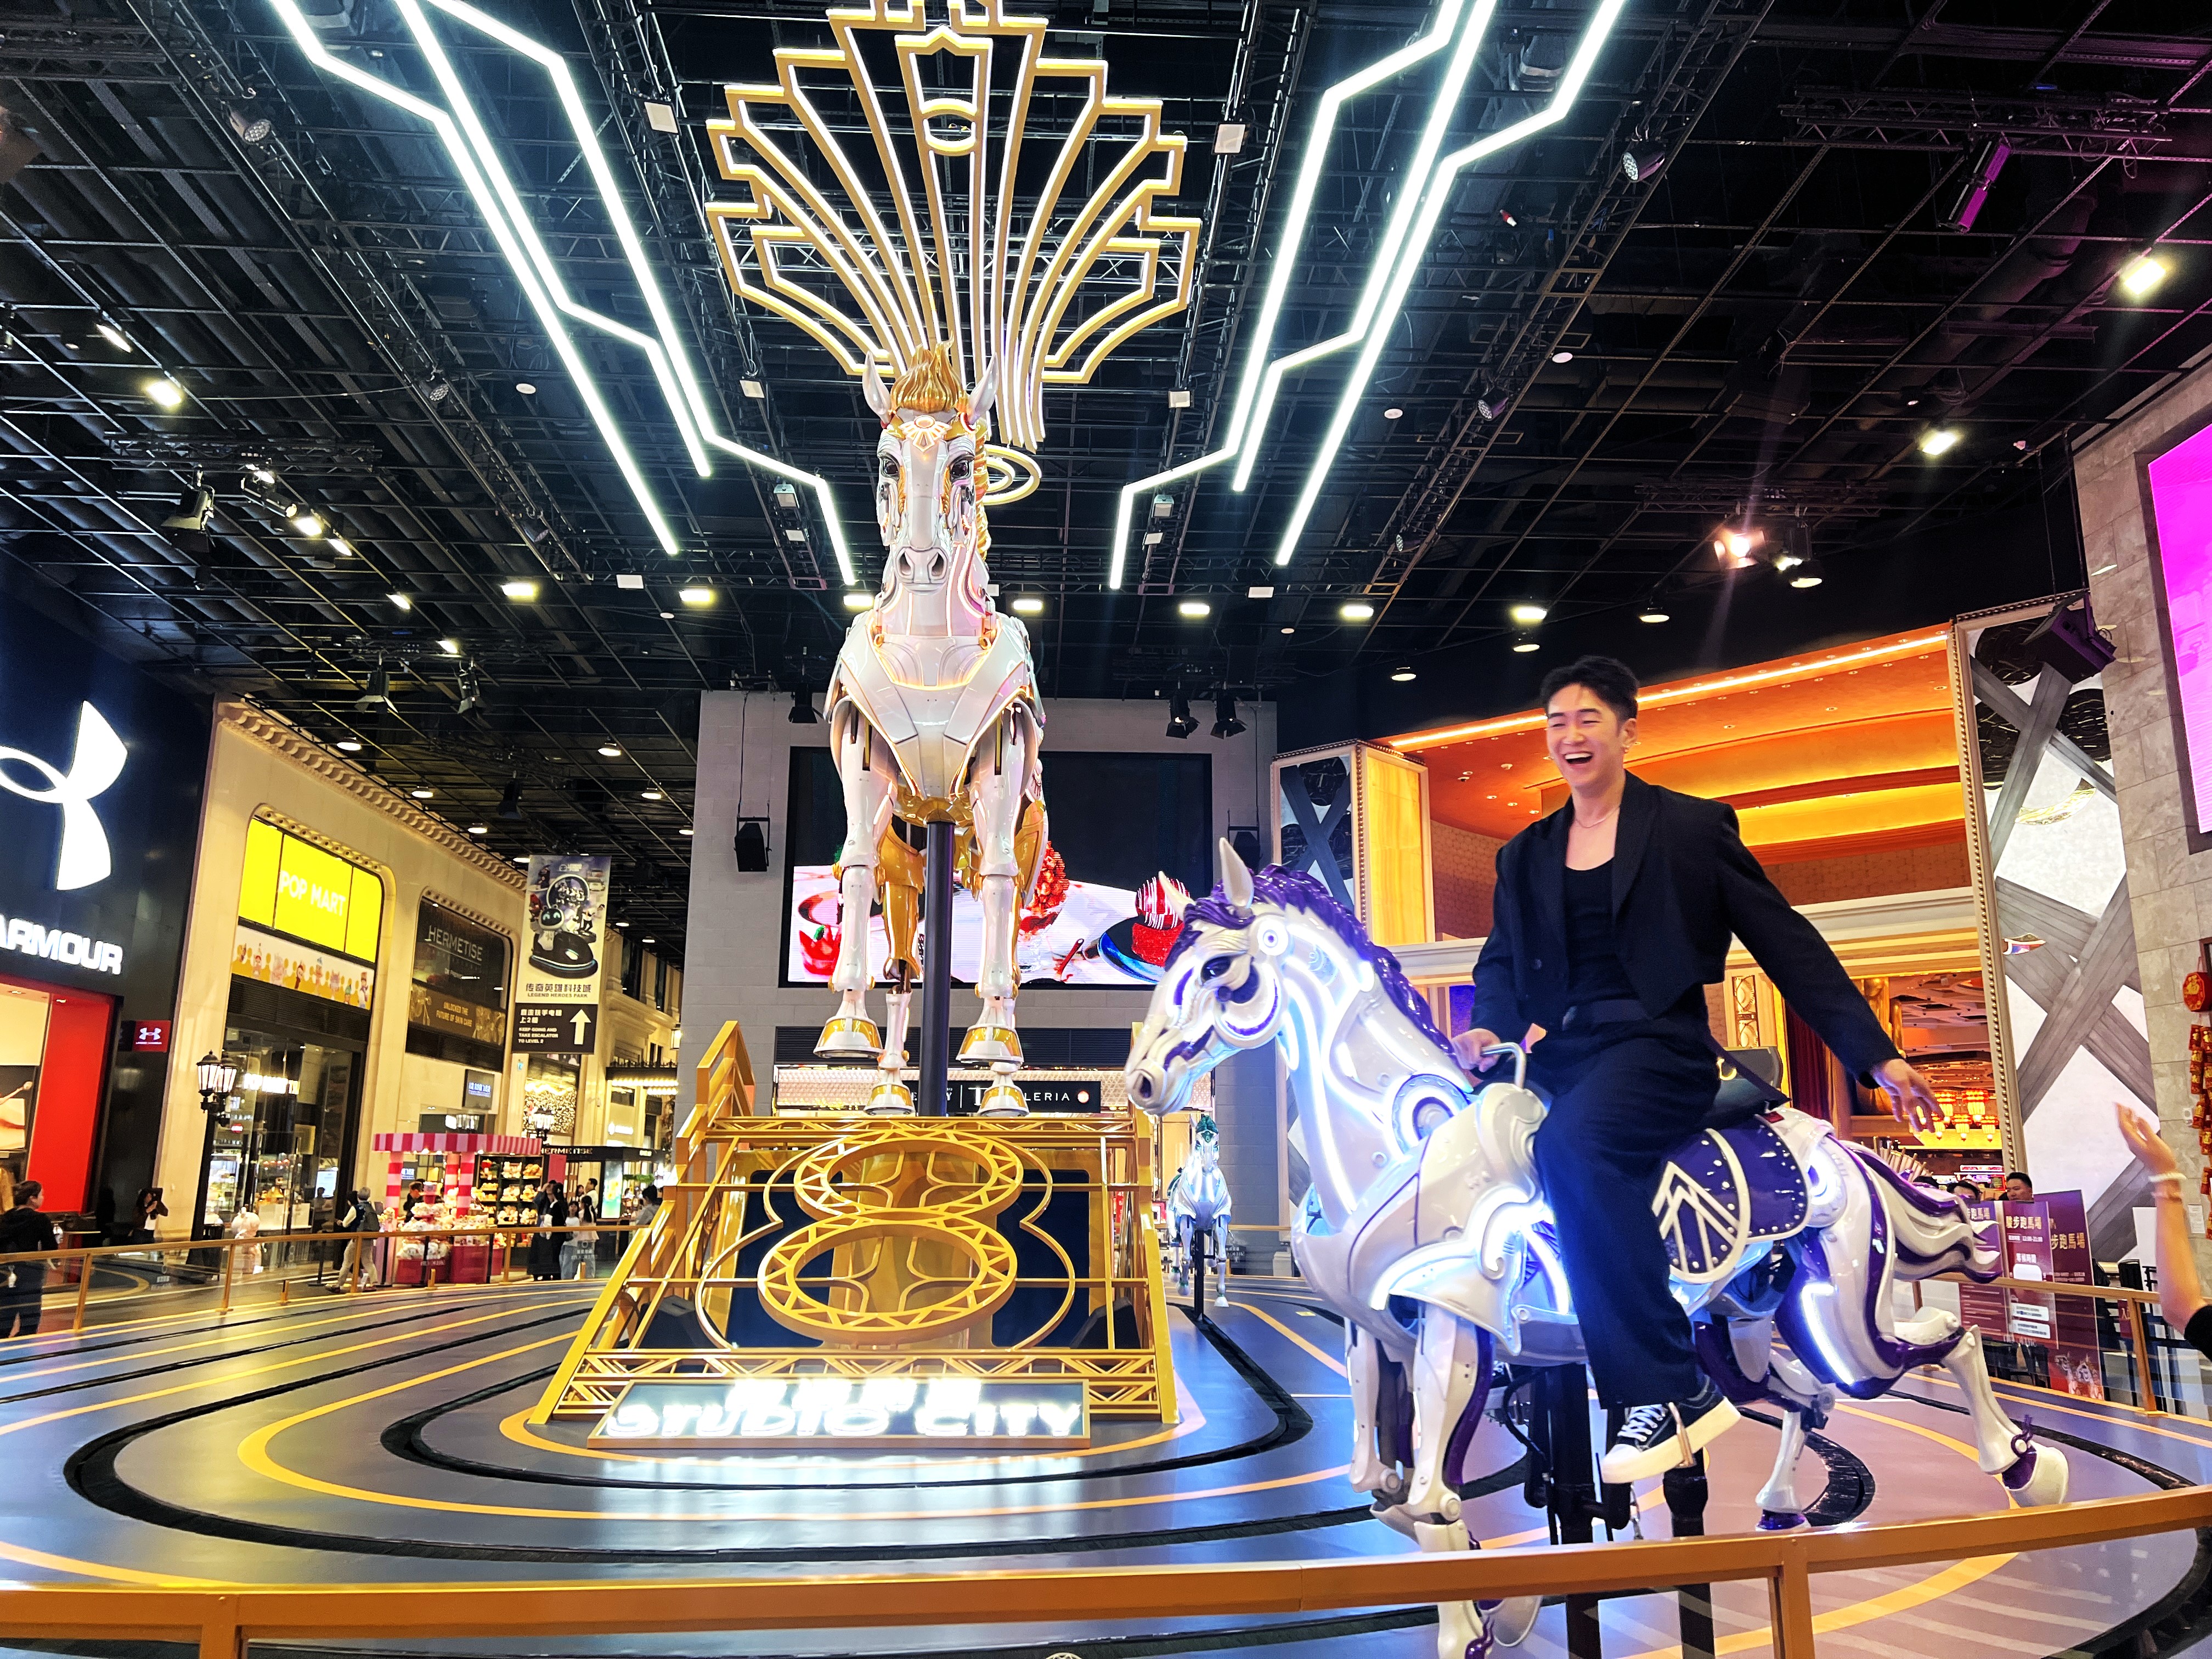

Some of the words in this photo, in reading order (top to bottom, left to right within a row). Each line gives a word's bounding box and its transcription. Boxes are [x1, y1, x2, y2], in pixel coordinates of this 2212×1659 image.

[278, 870, 307, 900] POP
[311, 883, 346, 916] MART
[427, 925, 483, 961] HERMETISE
[1025, 1092, 1070, 1101] LERIA
[2051, 1232, 2085, 1250] 步跑馬場
[606, 1403, 890, 1437] STUDIO
[915, 1403, 1081, 1437] CITY
